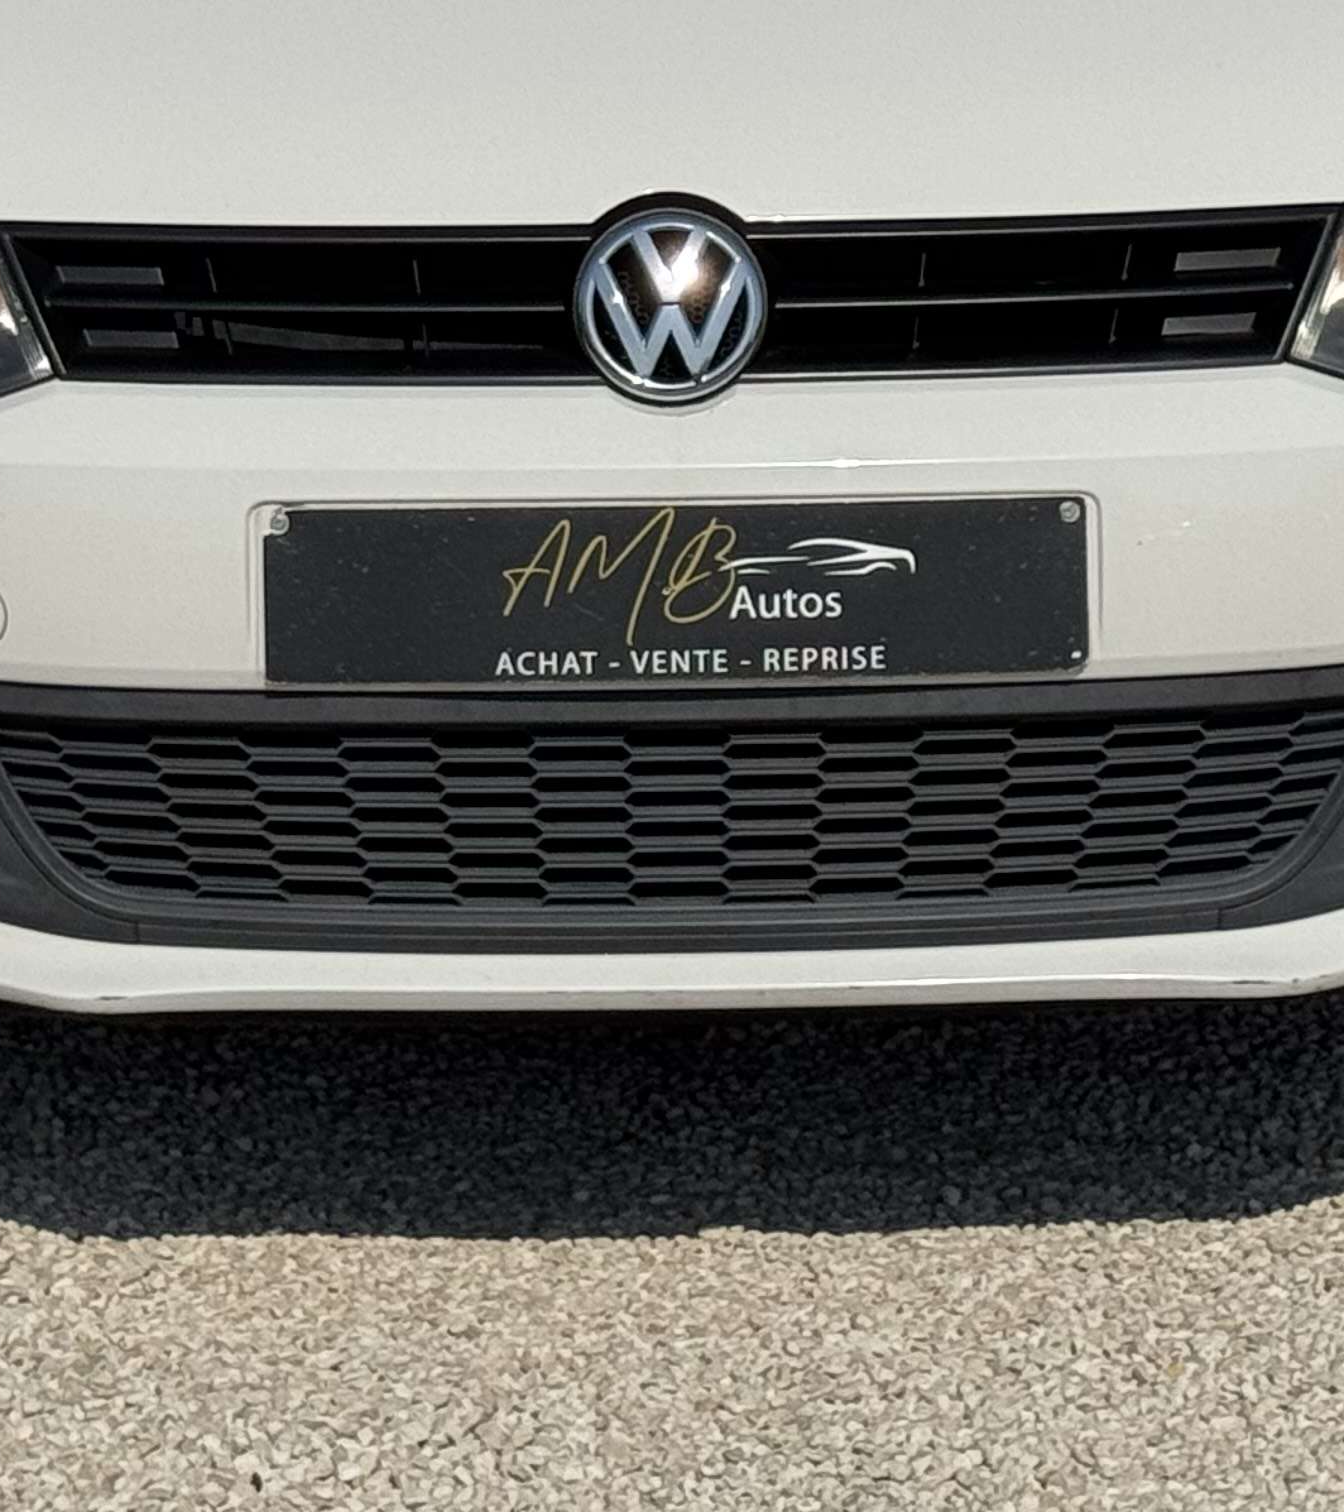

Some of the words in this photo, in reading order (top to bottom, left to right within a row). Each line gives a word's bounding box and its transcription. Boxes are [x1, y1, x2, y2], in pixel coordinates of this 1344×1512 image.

[586, 221, 756, 388] VW
[503, 506, 740, 647] AMB
[729, 585, 843, 620] Autos
[494, 650, 599, 676] ACHAT
[628, 648, 730, 675] VENTE
[762, 644, 887, 673] REPRISE
